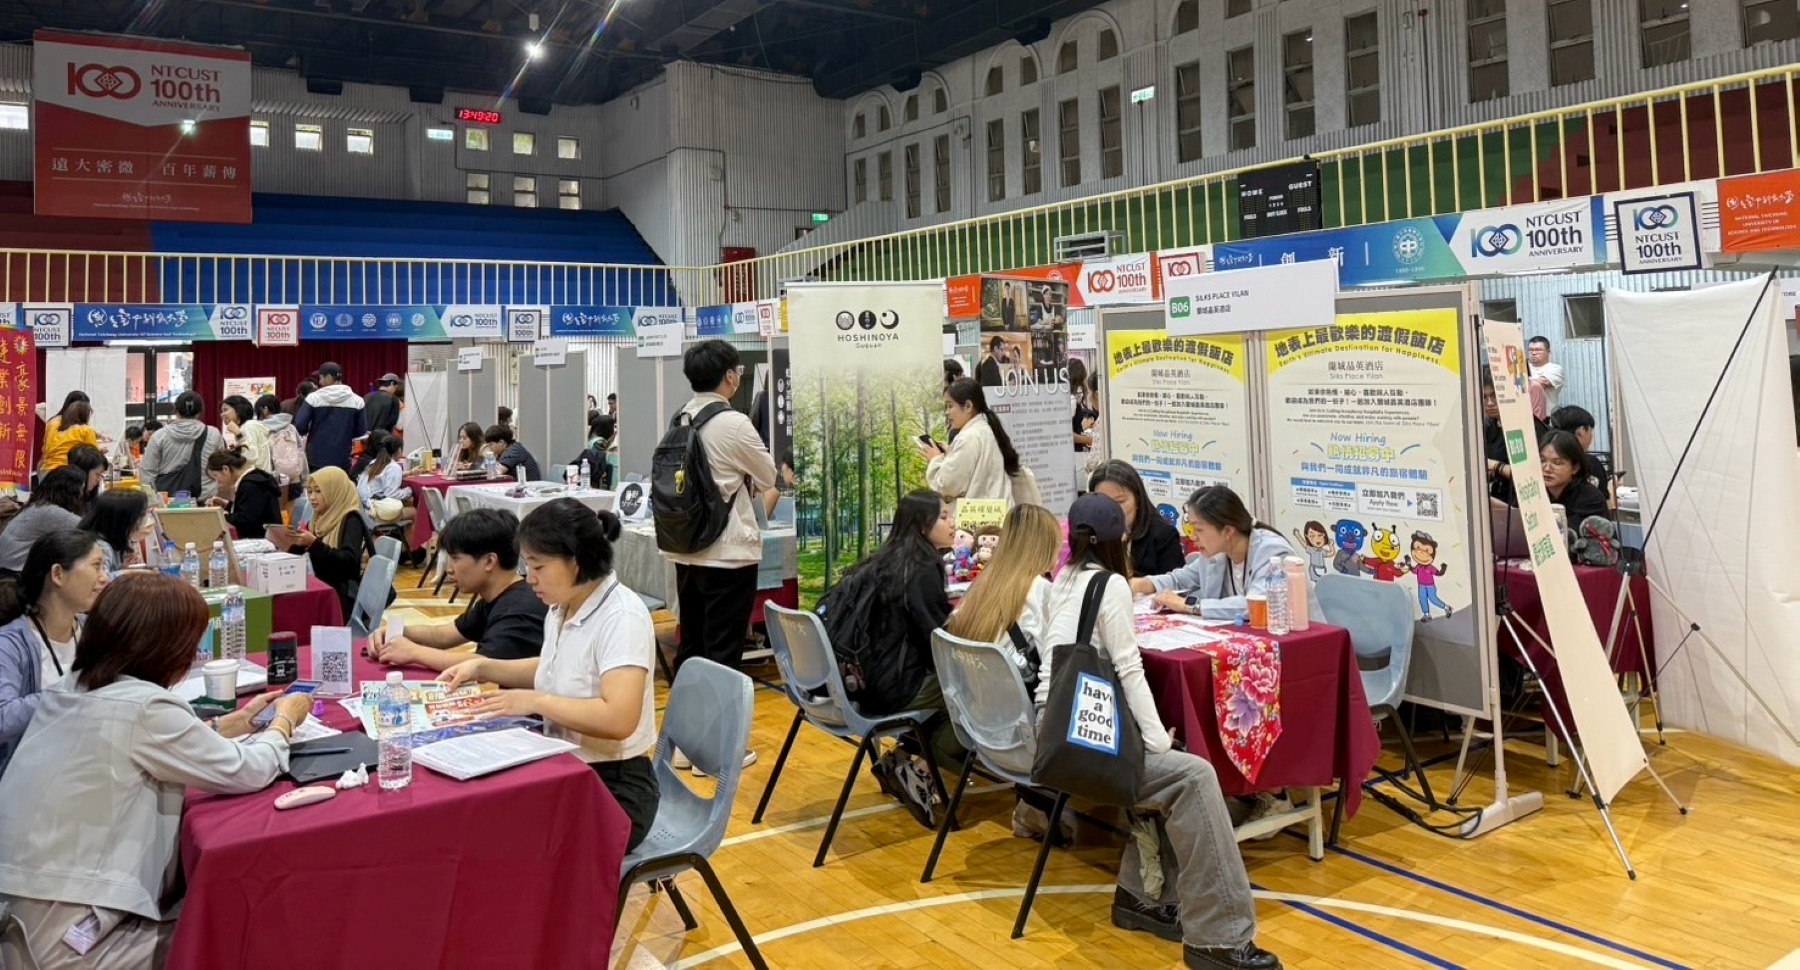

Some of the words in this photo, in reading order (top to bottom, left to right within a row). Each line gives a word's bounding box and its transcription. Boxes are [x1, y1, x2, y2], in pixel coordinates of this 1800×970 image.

[152, 64, 221, 82] NTCUST
[151, 79, 221, 103] 100th
[152, 100, 221, 112] ANNIVERSARY
[459, 109, 498, 122] 13:49:20
[52, 157, 134, 174] 遠大密微
[162, 162, 236, 180] 百年薪傳
[1288, 181, 1312, 190] GUEST
[1241, 189, 1263, 197] HOME
[1526, 211, 1581, 228] NTCUST
[1526, 225, 1583, 249] 100th
[1635, 231, 1680, 244] NTCUST
[1528, 246, 1584, 258] ANNIVERSARY
[1635, 242, 1682, 259] 100th
[1638, 256, 1683, 265] ANNIVERSARY
[1116, 262, 1145, 273] NTCUST
[1116, 274, 1146, 288] 100th
[1212, 291, 1230, 299] PLACE
[1231, 289, 1249, 297] YILAN
[1171, 302, 1189, 314] B06
[220, 326, 247, 335] 100th
[267, 331, 290, 339] 100th
[837, 333, 899, 342] HOSHINOYA
[1274, 324, 1446, 358] 地表上最歡樂的渡假飯店
[1334, 344, 1379, 352] Destination
[994, 368, 1039, 397] JOIN
[1044, 367, 1070, 394] US
[1153, 430, 1169, 438] Now
[1170, 430, 1193, 442] Hiring
[1330, 432, 1351, 442] Now
[1355, 433, 1386, 446] Hiring
[1093, 702, 1103, 712] a
[1077, 725, 1111, 744] time
